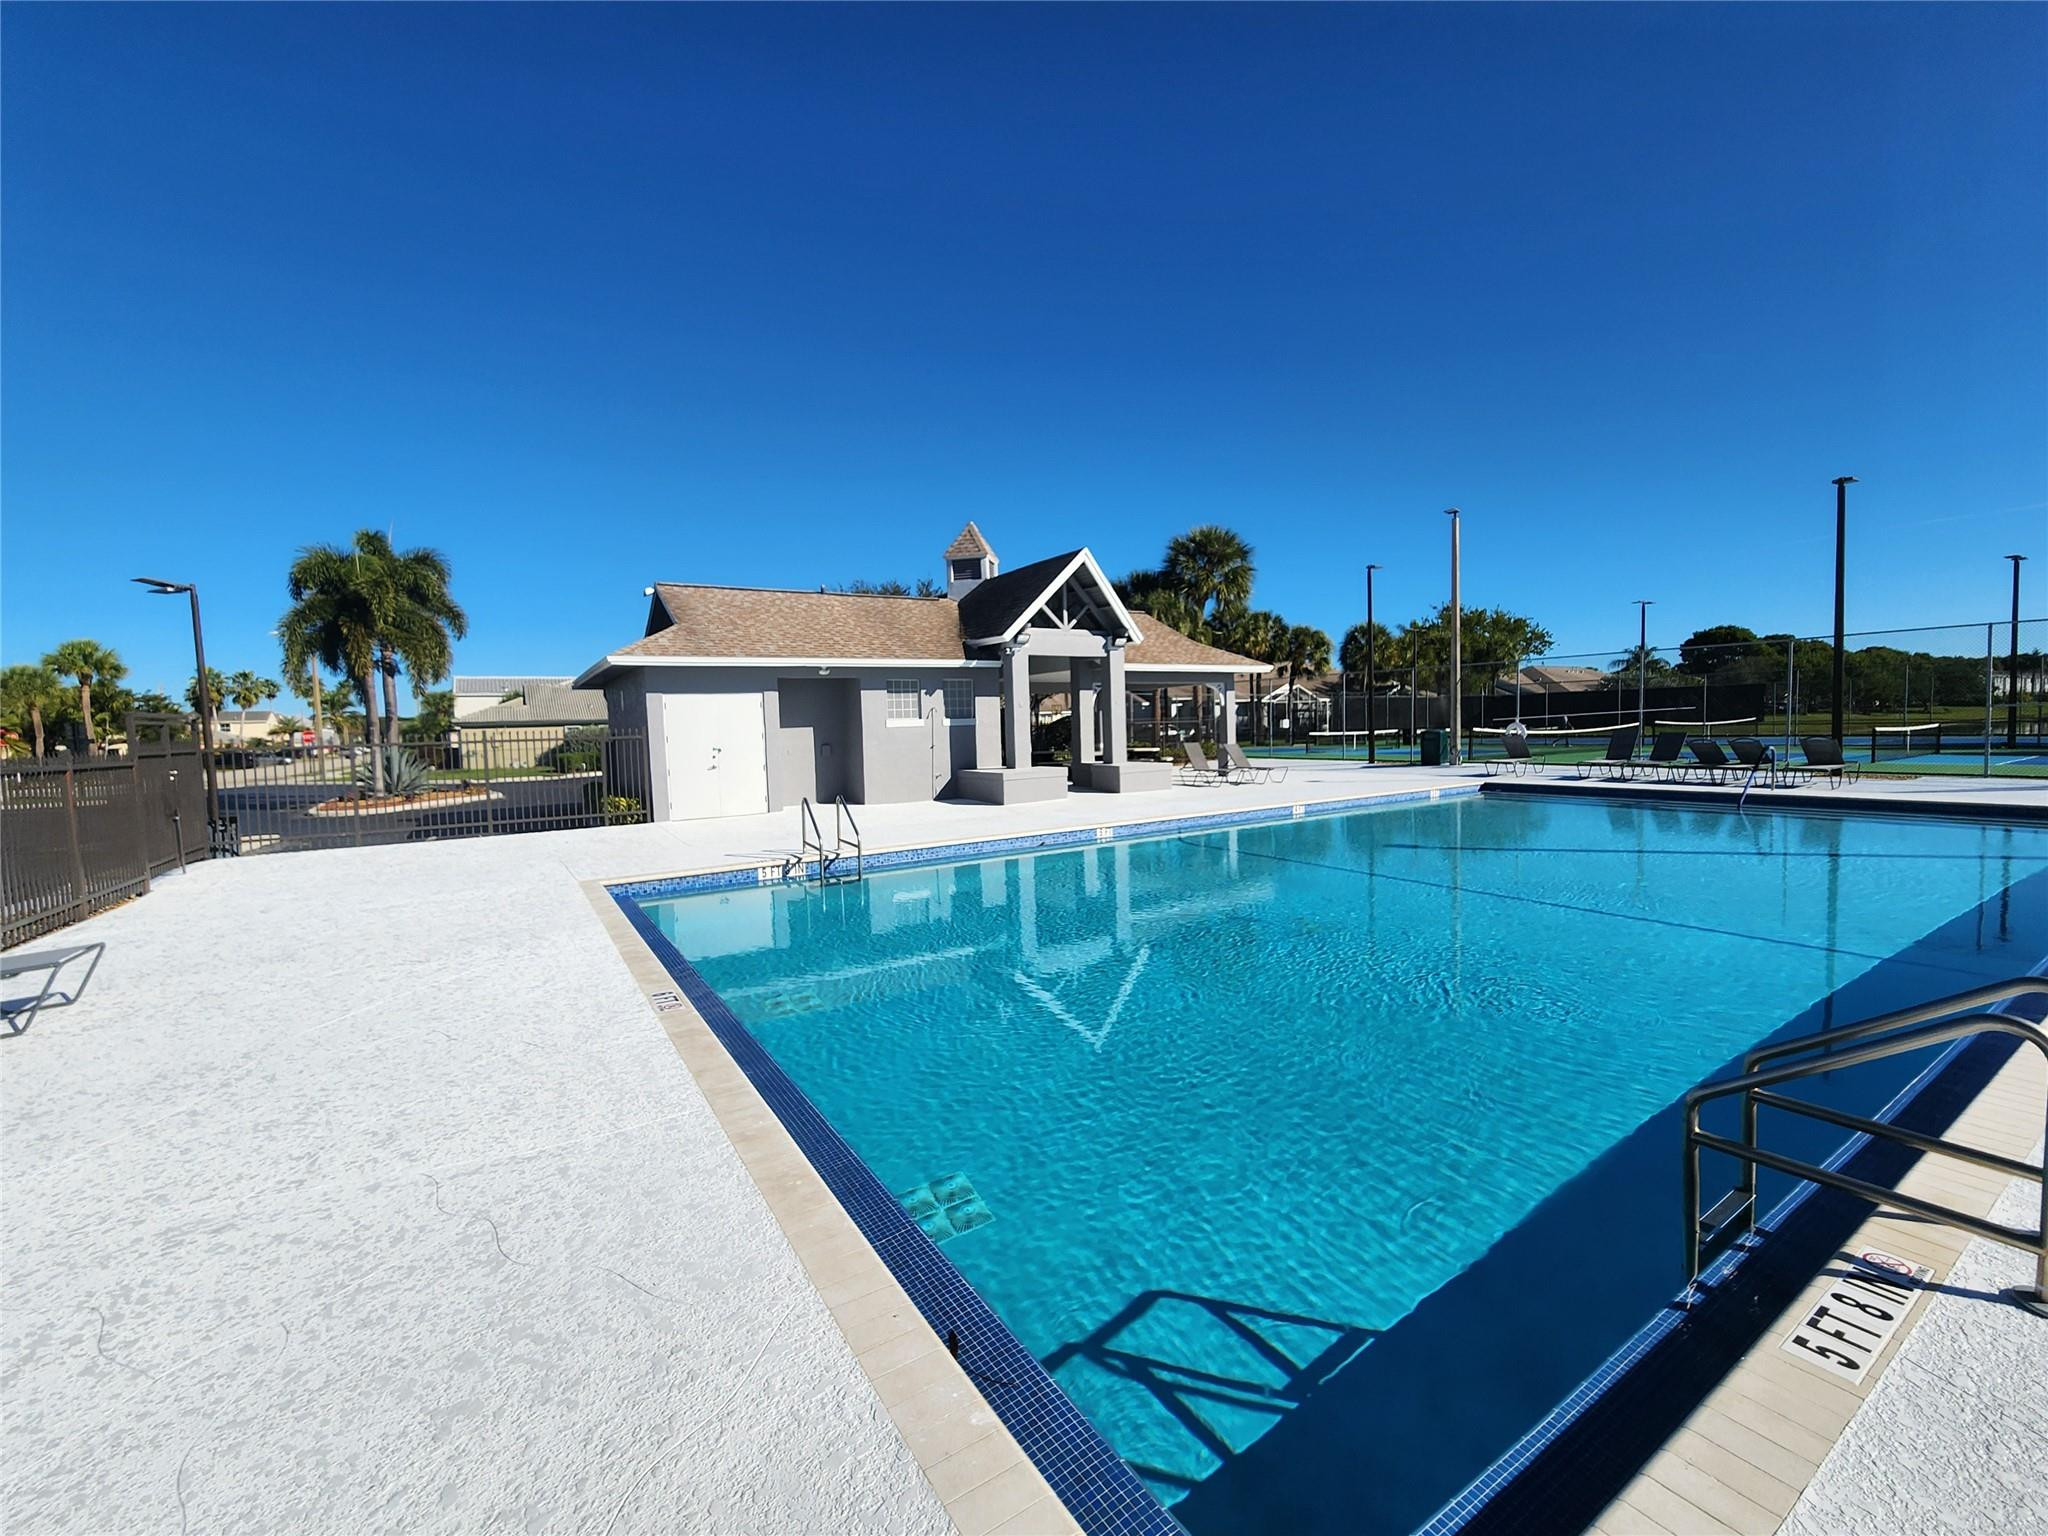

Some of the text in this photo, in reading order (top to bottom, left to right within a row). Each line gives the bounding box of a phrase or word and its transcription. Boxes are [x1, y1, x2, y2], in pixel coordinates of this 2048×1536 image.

[762, 867, 767, 878] 5
[771, 865, 781, 877] FT
[1792, 1266, 1915, 1371] 5 FT 8 IN
